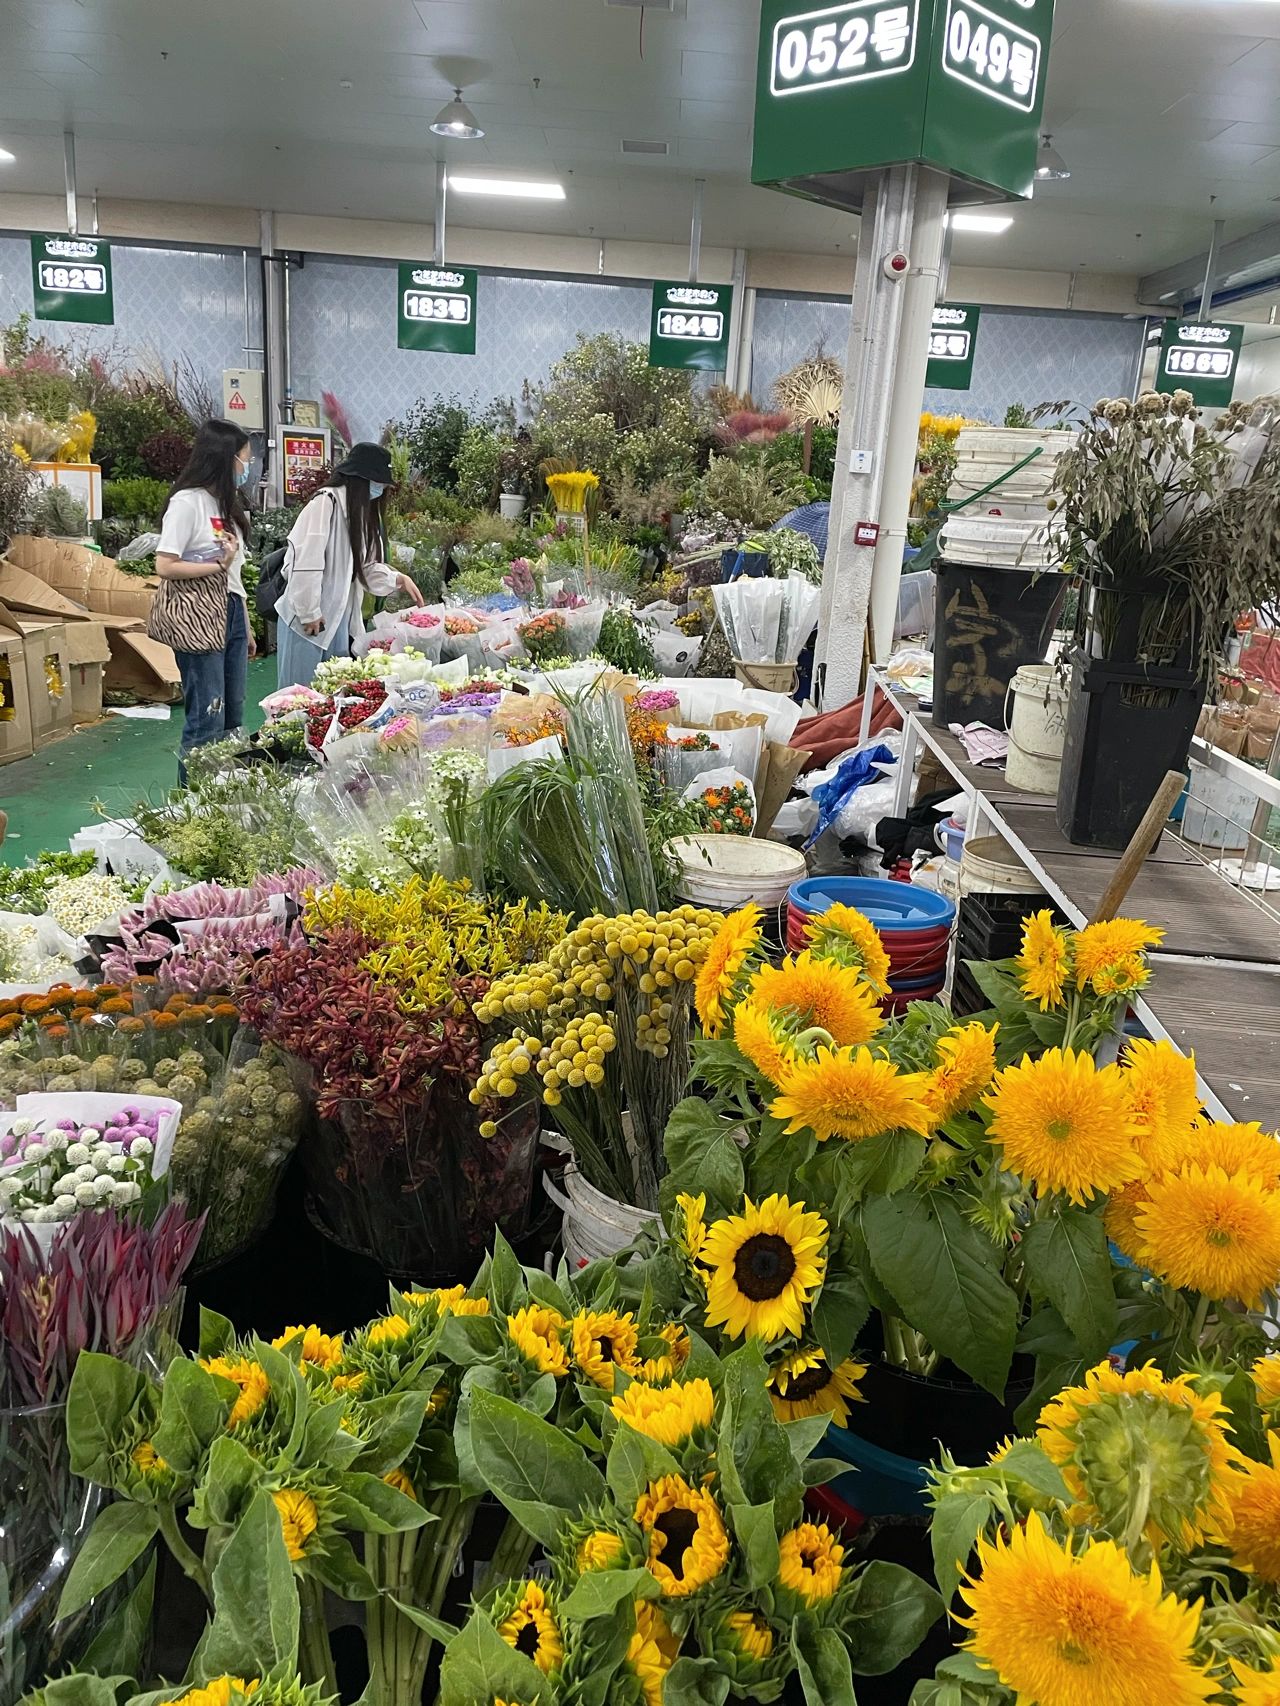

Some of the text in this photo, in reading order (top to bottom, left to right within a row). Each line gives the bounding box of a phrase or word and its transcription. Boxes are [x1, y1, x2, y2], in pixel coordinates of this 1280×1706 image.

[779, 6, 910, 80] 052号
[950, 10, 1034, 95] 049号
[43, 267, 102, 289] 182号
[408, 296, 467, 319] 183号
[661, 314, 719, 336] 184号
[1170, 351, 1229, 373] 186号
